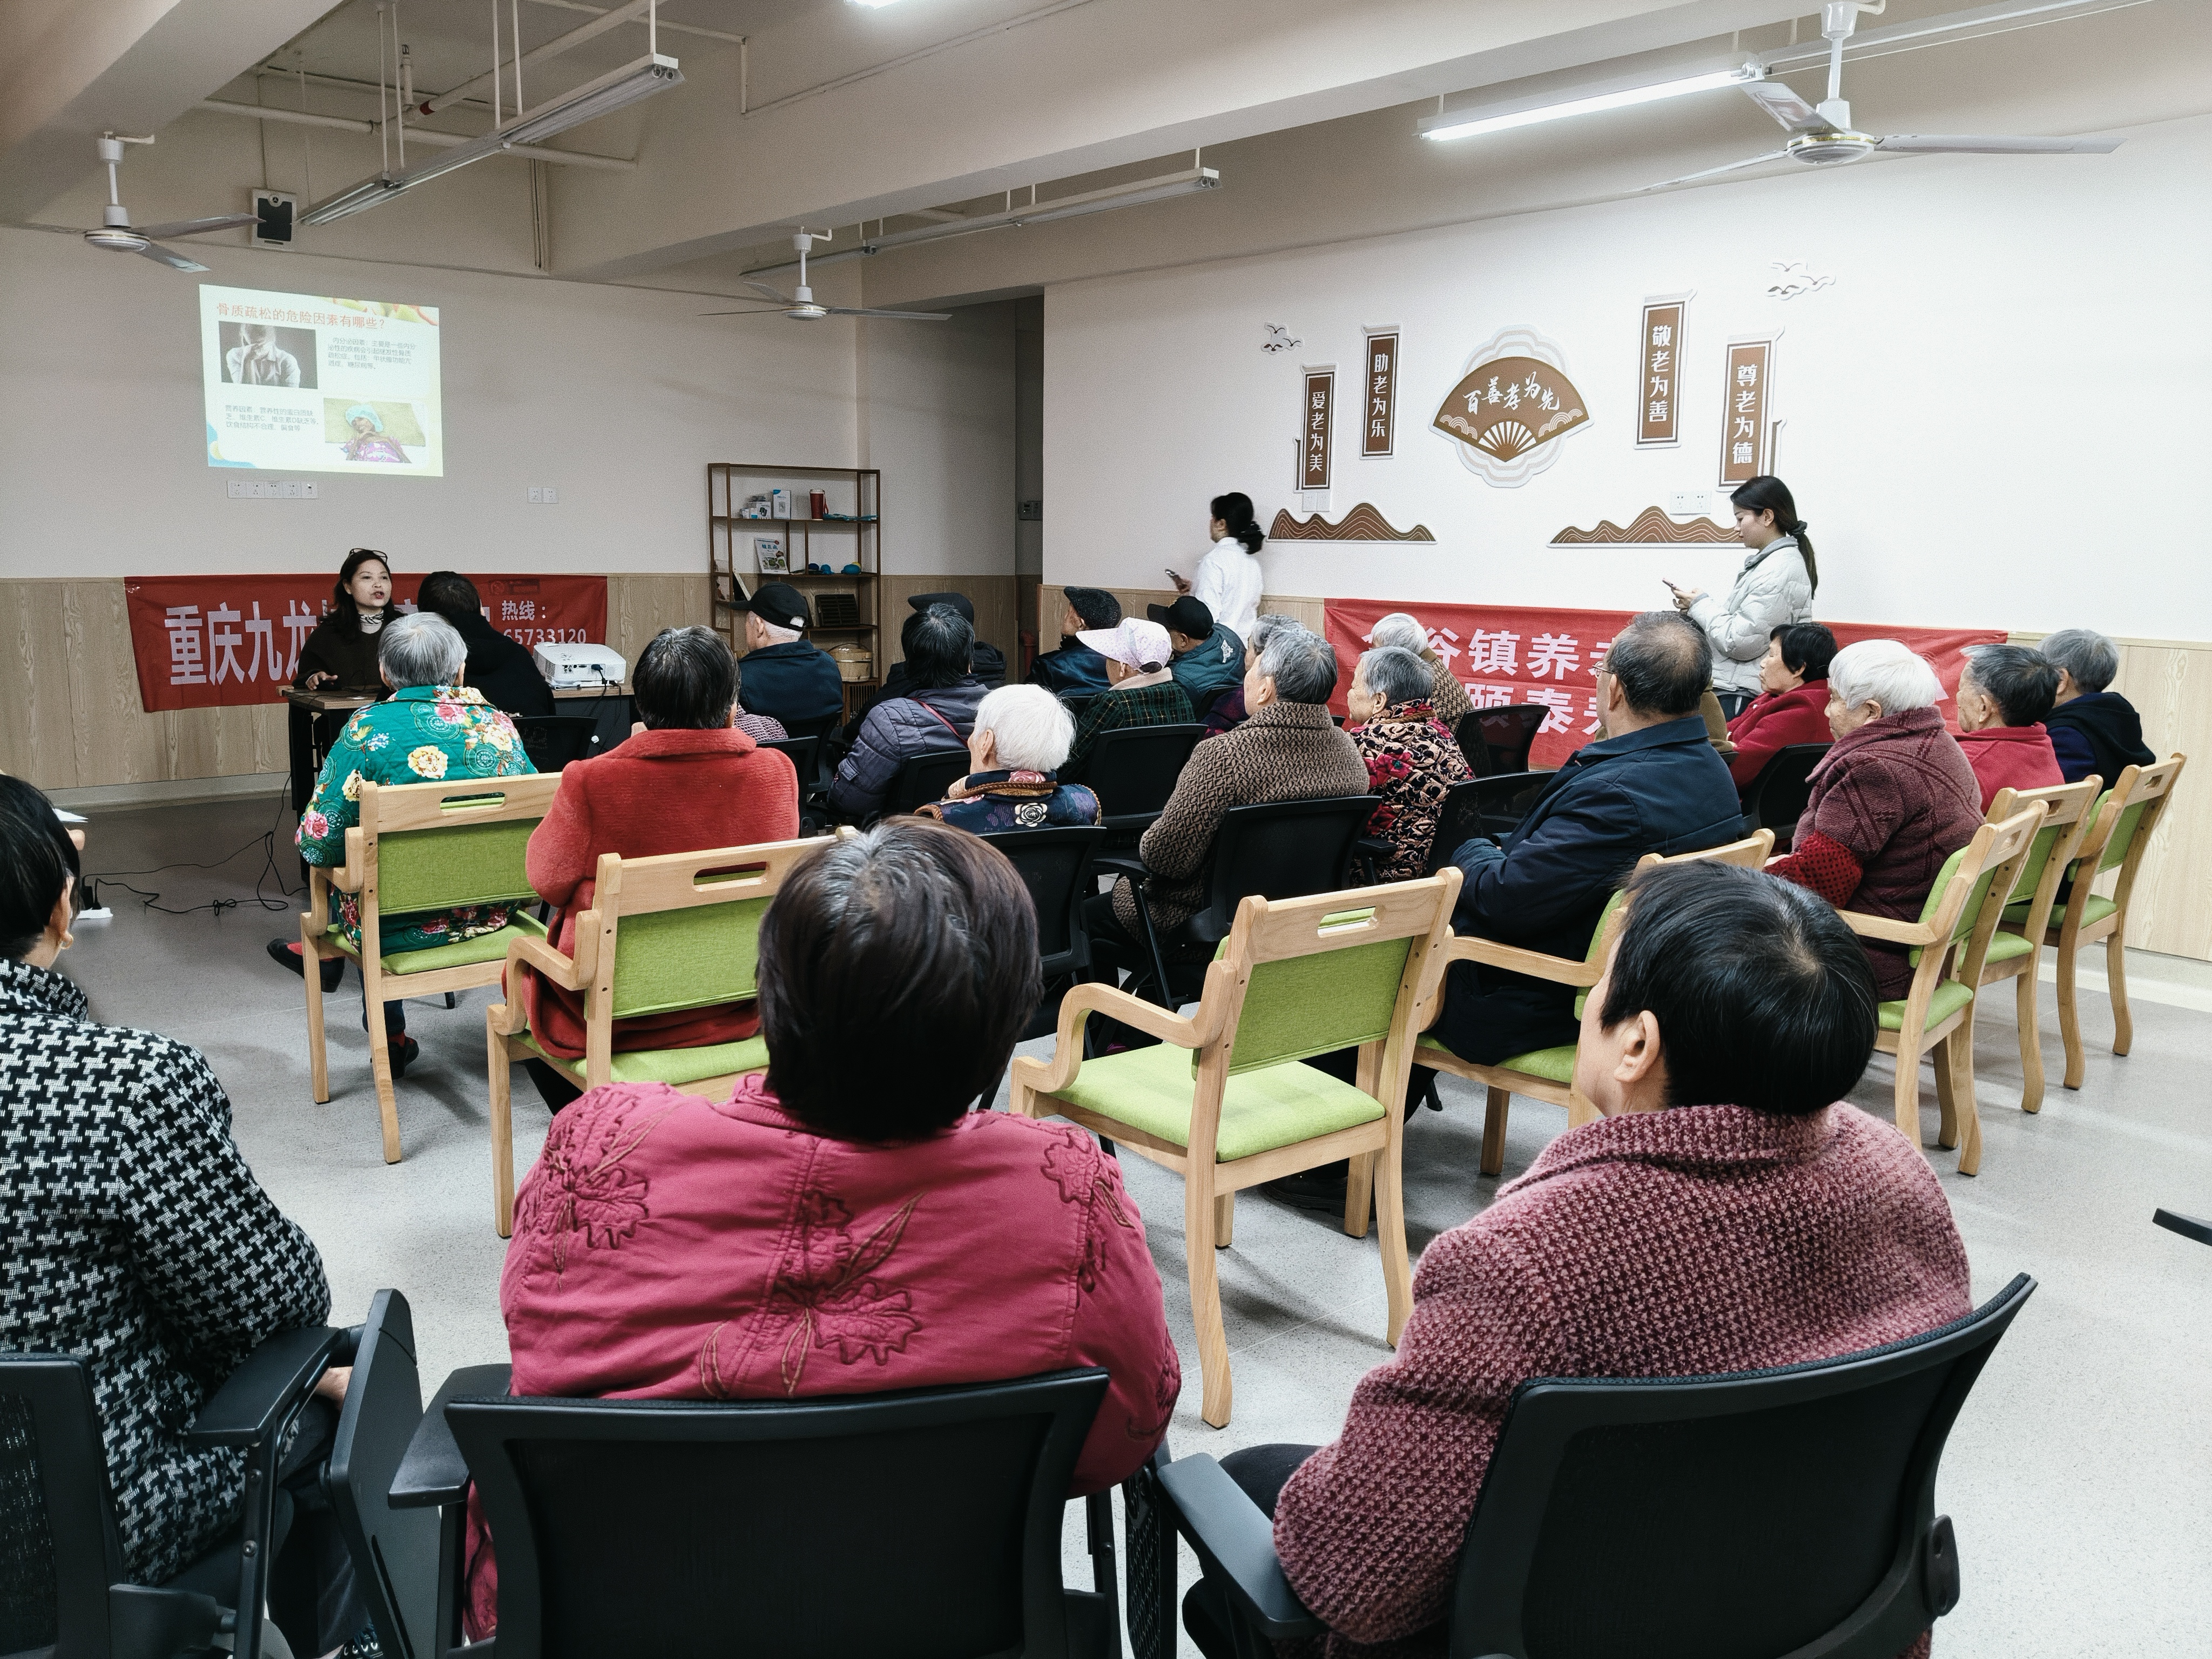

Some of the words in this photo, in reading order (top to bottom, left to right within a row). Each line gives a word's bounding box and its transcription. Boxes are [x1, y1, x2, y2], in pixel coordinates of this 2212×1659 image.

[1371, 353, 1388, 437] 助老为乐
[1462, 371, 1560, 415] 百善孝为先
[1649, 325, 1671, 422] 敬老为善
[1732, 363, 1757, 464] 尊老为德
[1310, 391, 1325, 471] 爱老为美
[164, 599, 328, 686] 重庆九龙
[503, 628, 586, 645] 65733120
